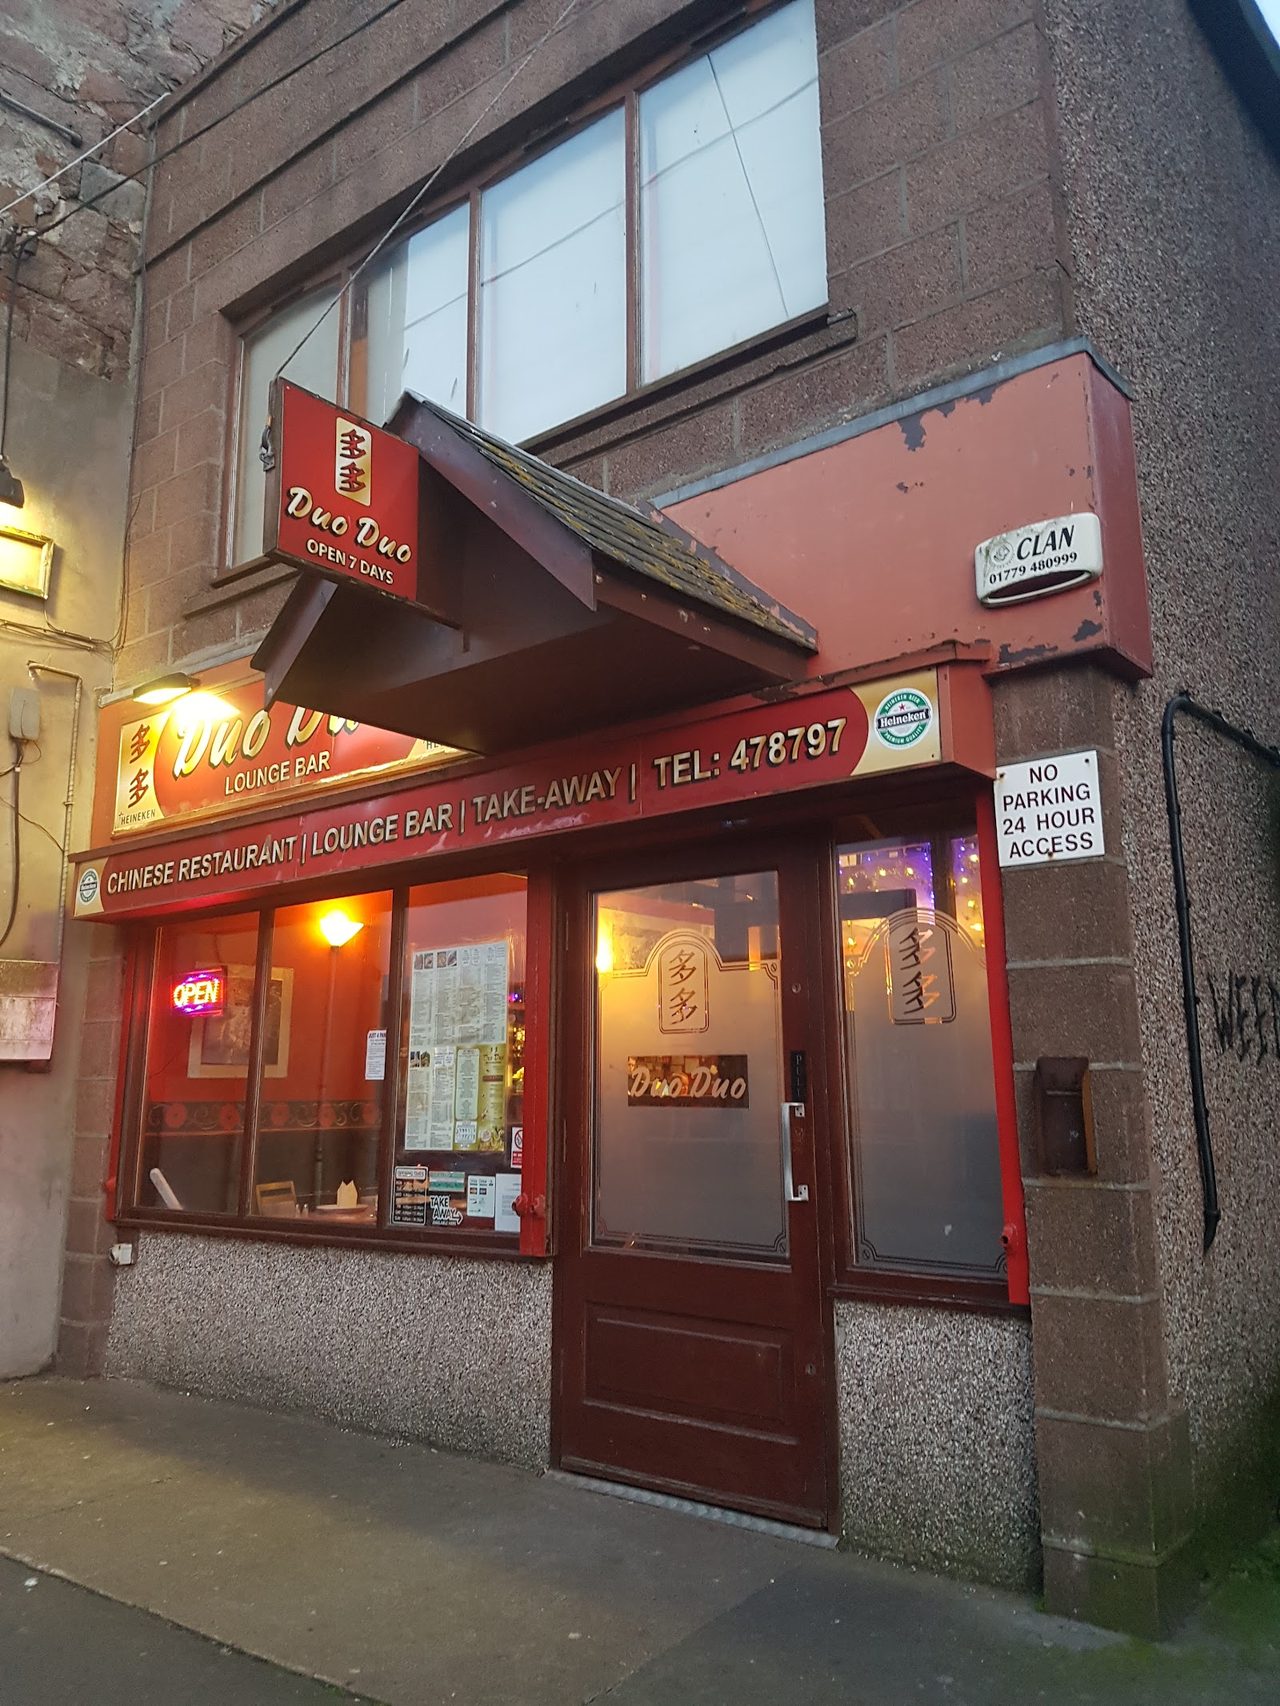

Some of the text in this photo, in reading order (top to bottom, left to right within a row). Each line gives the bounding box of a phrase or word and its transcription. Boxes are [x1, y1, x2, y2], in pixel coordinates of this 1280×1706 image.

[287, 487, 412, 564] Duo Duo
[1016, 525, 1074, 560] CLAN
[306, 538, 394, 585] OPEN 7 DAYS
[989, 552, 1077, 584] 01779 480999
[880, 713, 927, 729] Heineken
[224, 750, 331, 796] LOUNGE BAR
[1029, 763, 1059, 784] NO
[107, 861, 173, 894] CHINESE
[178, 836, 297, 883] RESTAURANT
[311, 814, 399, 855] LOUNGE
[404, 804, 453, 837] BAR
[472, 766, 622, 825] TAKE-AWAY
[653, 751, 722, 789] TEL:
[729, 717, 848, 773] 478797
[1002, 782, 1091, 813] PARKING
[121, 809, 156, 825] HEINEKEN
[1003, 806, 1096, 836] 24 HOUR
[1009, 832, 1094, 860] ACCESS
[173, 979, 219, 1008] OPEN
[630, 1066, 747, 1099] Duo Duo
[430, 1197, 449, 1208] TAKE
[433, 1207, 457, 1219] AWAY
